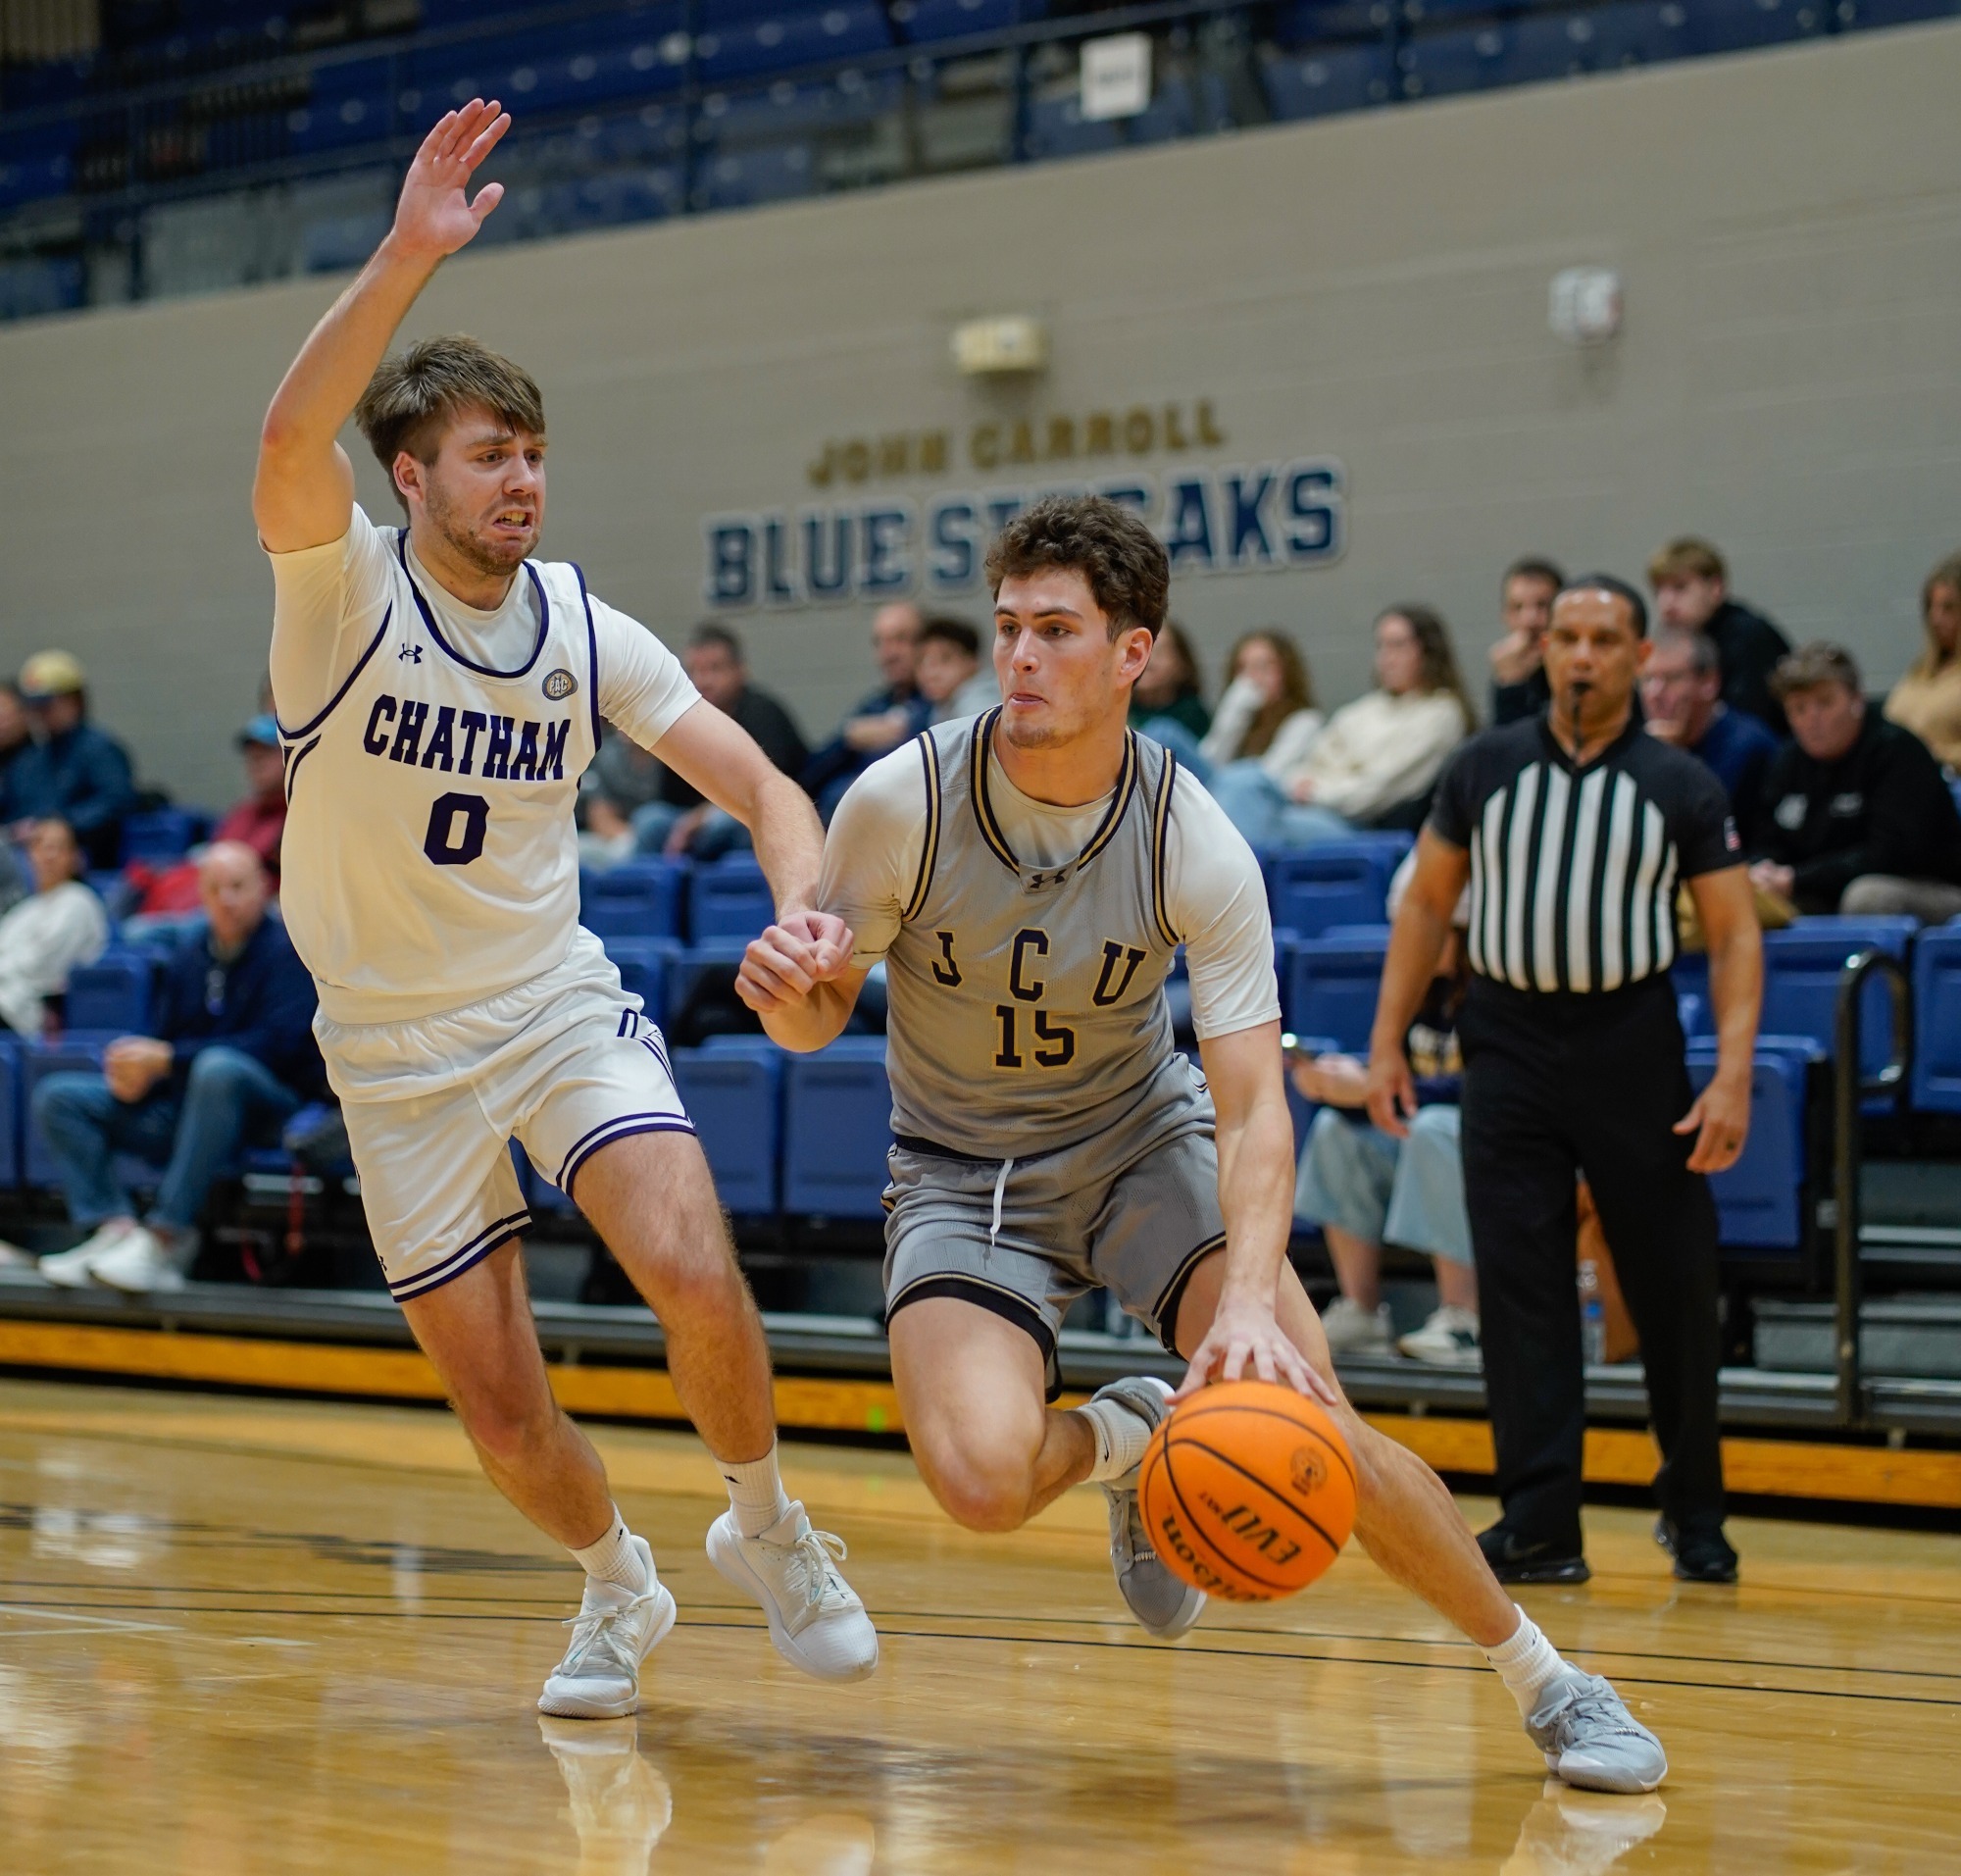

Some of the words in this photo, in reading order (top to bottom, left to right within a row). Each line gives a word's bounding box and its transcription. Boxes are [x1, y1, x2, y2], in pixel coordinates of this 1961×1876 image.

[808, 430, 948, 486] JOHN
[971, 398, 1225, 468] CARROLL
[708, 511, 909, 603] BLUE
[930, 465, 1339, 581] SAKS
[549, 678, 569, 693] PAC
[363, 693, 571, 782] CHATHAM
[424, 791, 490, 866] 0
[992, 1004, 1077, 1071] 15
[1221, 1504, 1302, 1565] EVO
